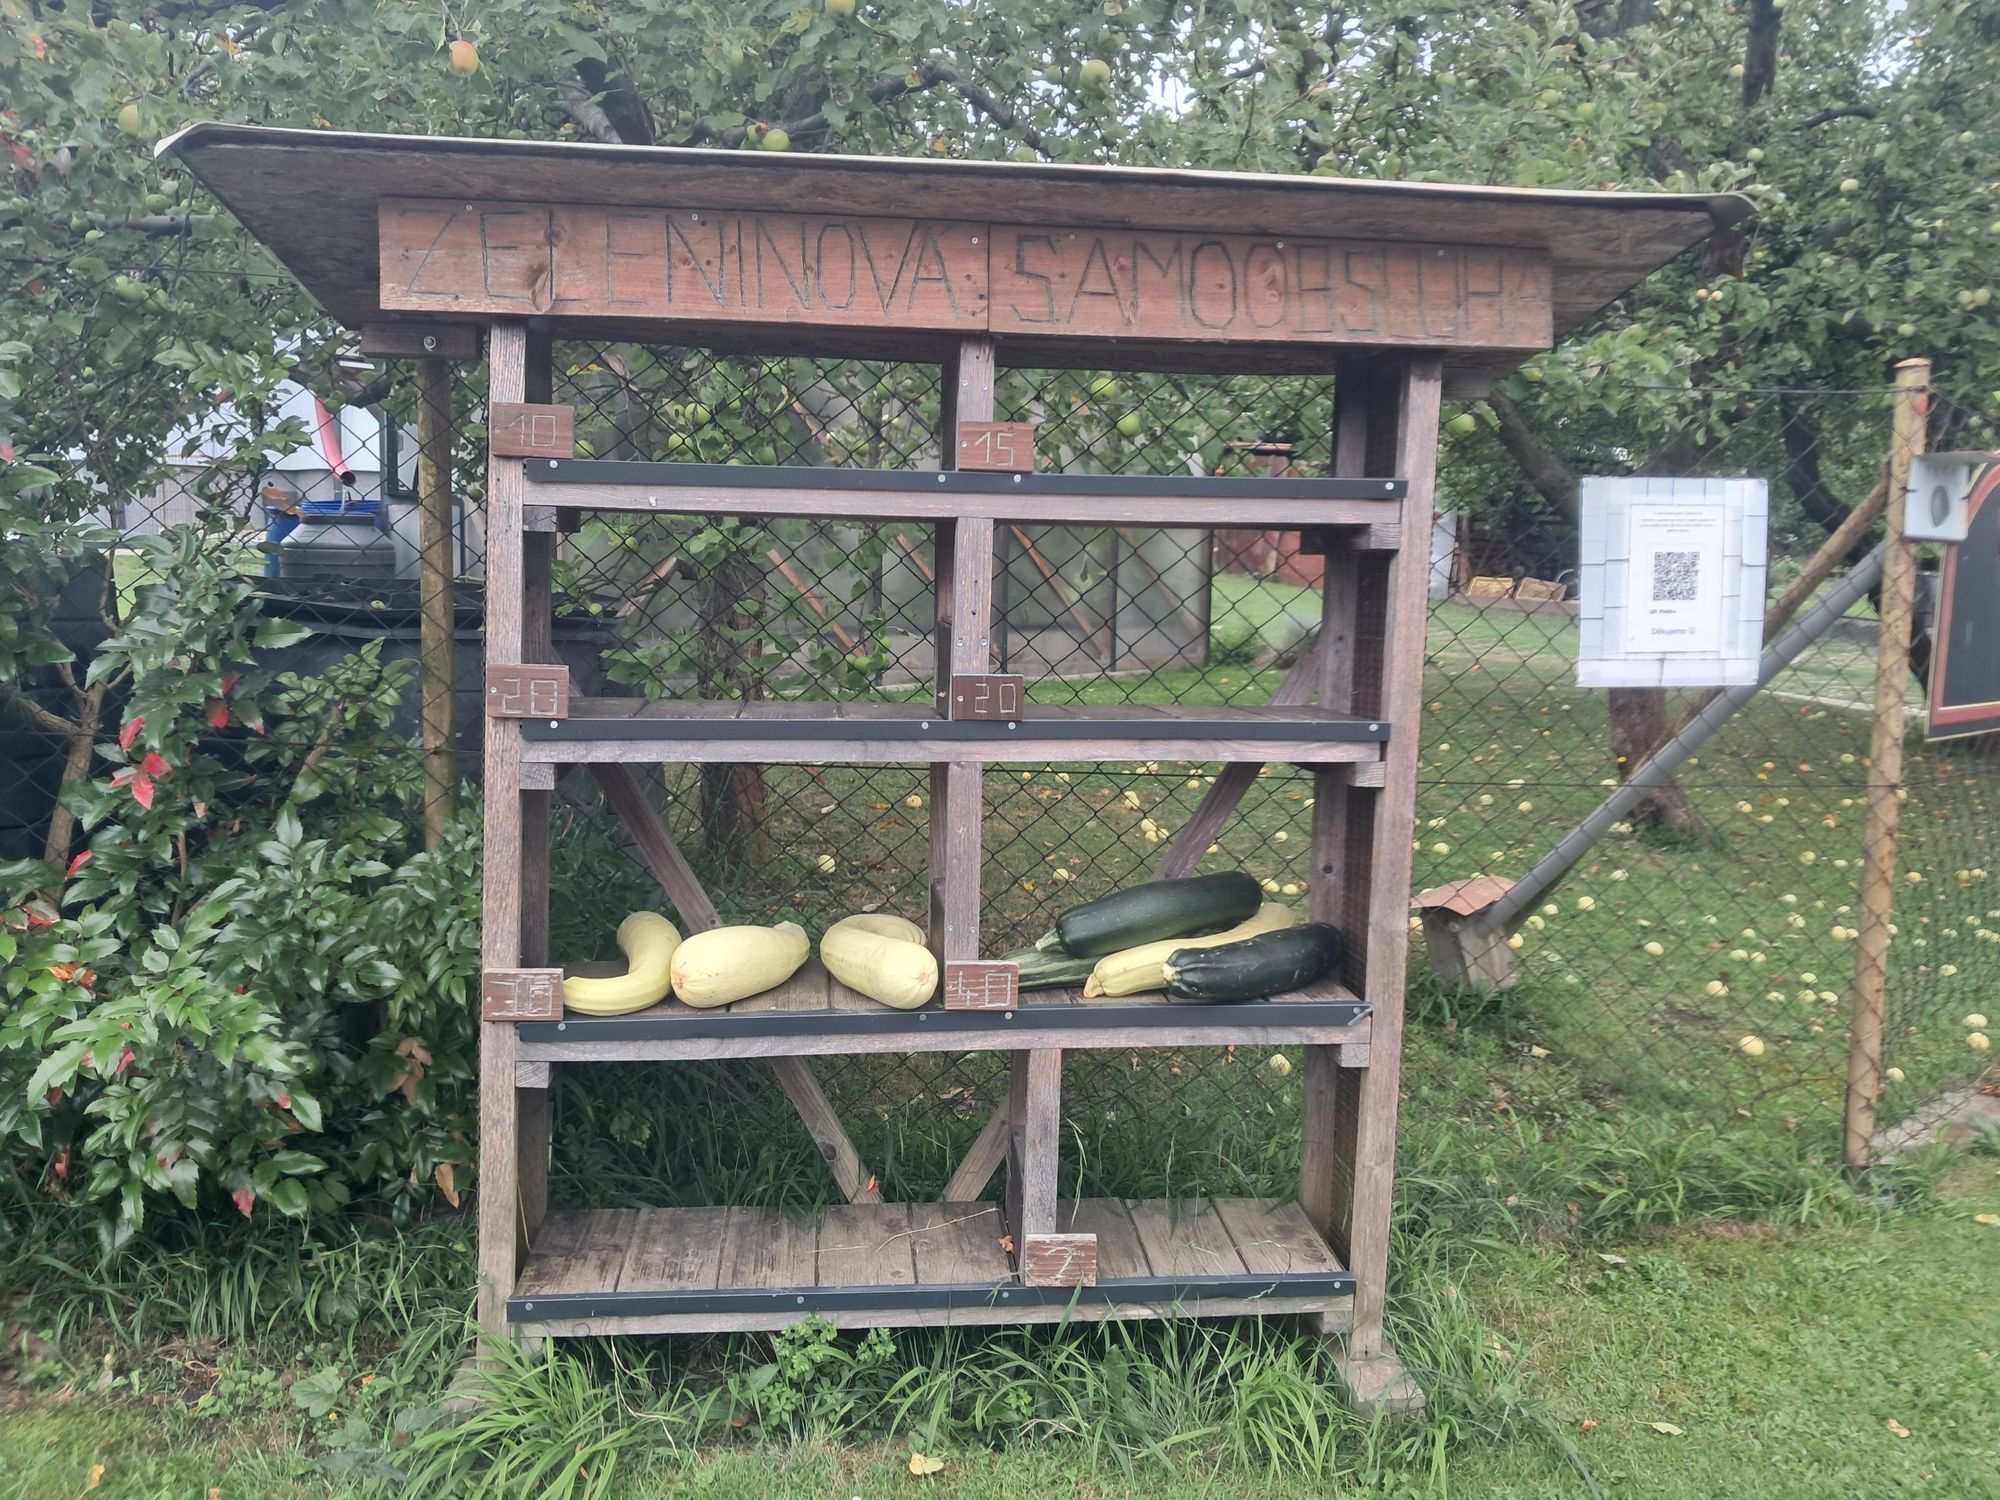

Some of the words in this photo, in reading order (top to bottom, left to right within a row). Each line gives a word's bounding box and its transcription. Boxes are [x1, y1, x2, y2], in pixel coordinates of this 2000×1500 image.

[506, 414, 556, 447] 10
[974, 431, 1017, 467] 15
[502, 677, 558, 715] 20
[974, 683, 1016, 713] 20
[958, 970, 1012, 1007] 40
